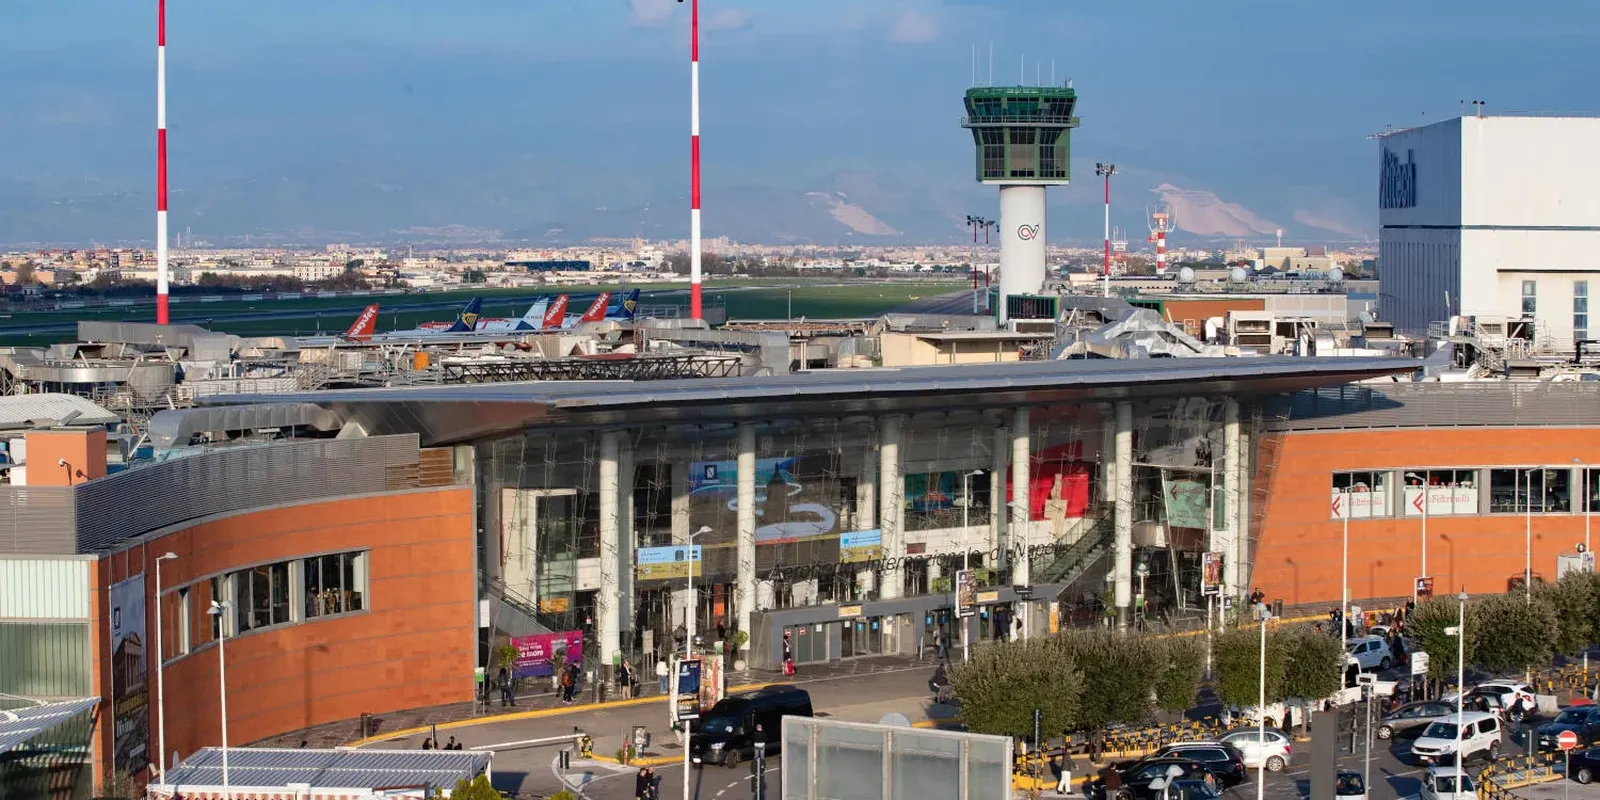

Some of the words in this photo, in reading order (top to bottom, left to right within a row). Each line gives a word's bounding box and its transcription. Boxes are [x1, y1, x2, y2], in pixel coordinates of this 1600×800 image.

[865, 546, 981, 572] Internazionale
[990, 541, 1005, 561] di
[1014, 540, 1064, 561] Napoli
